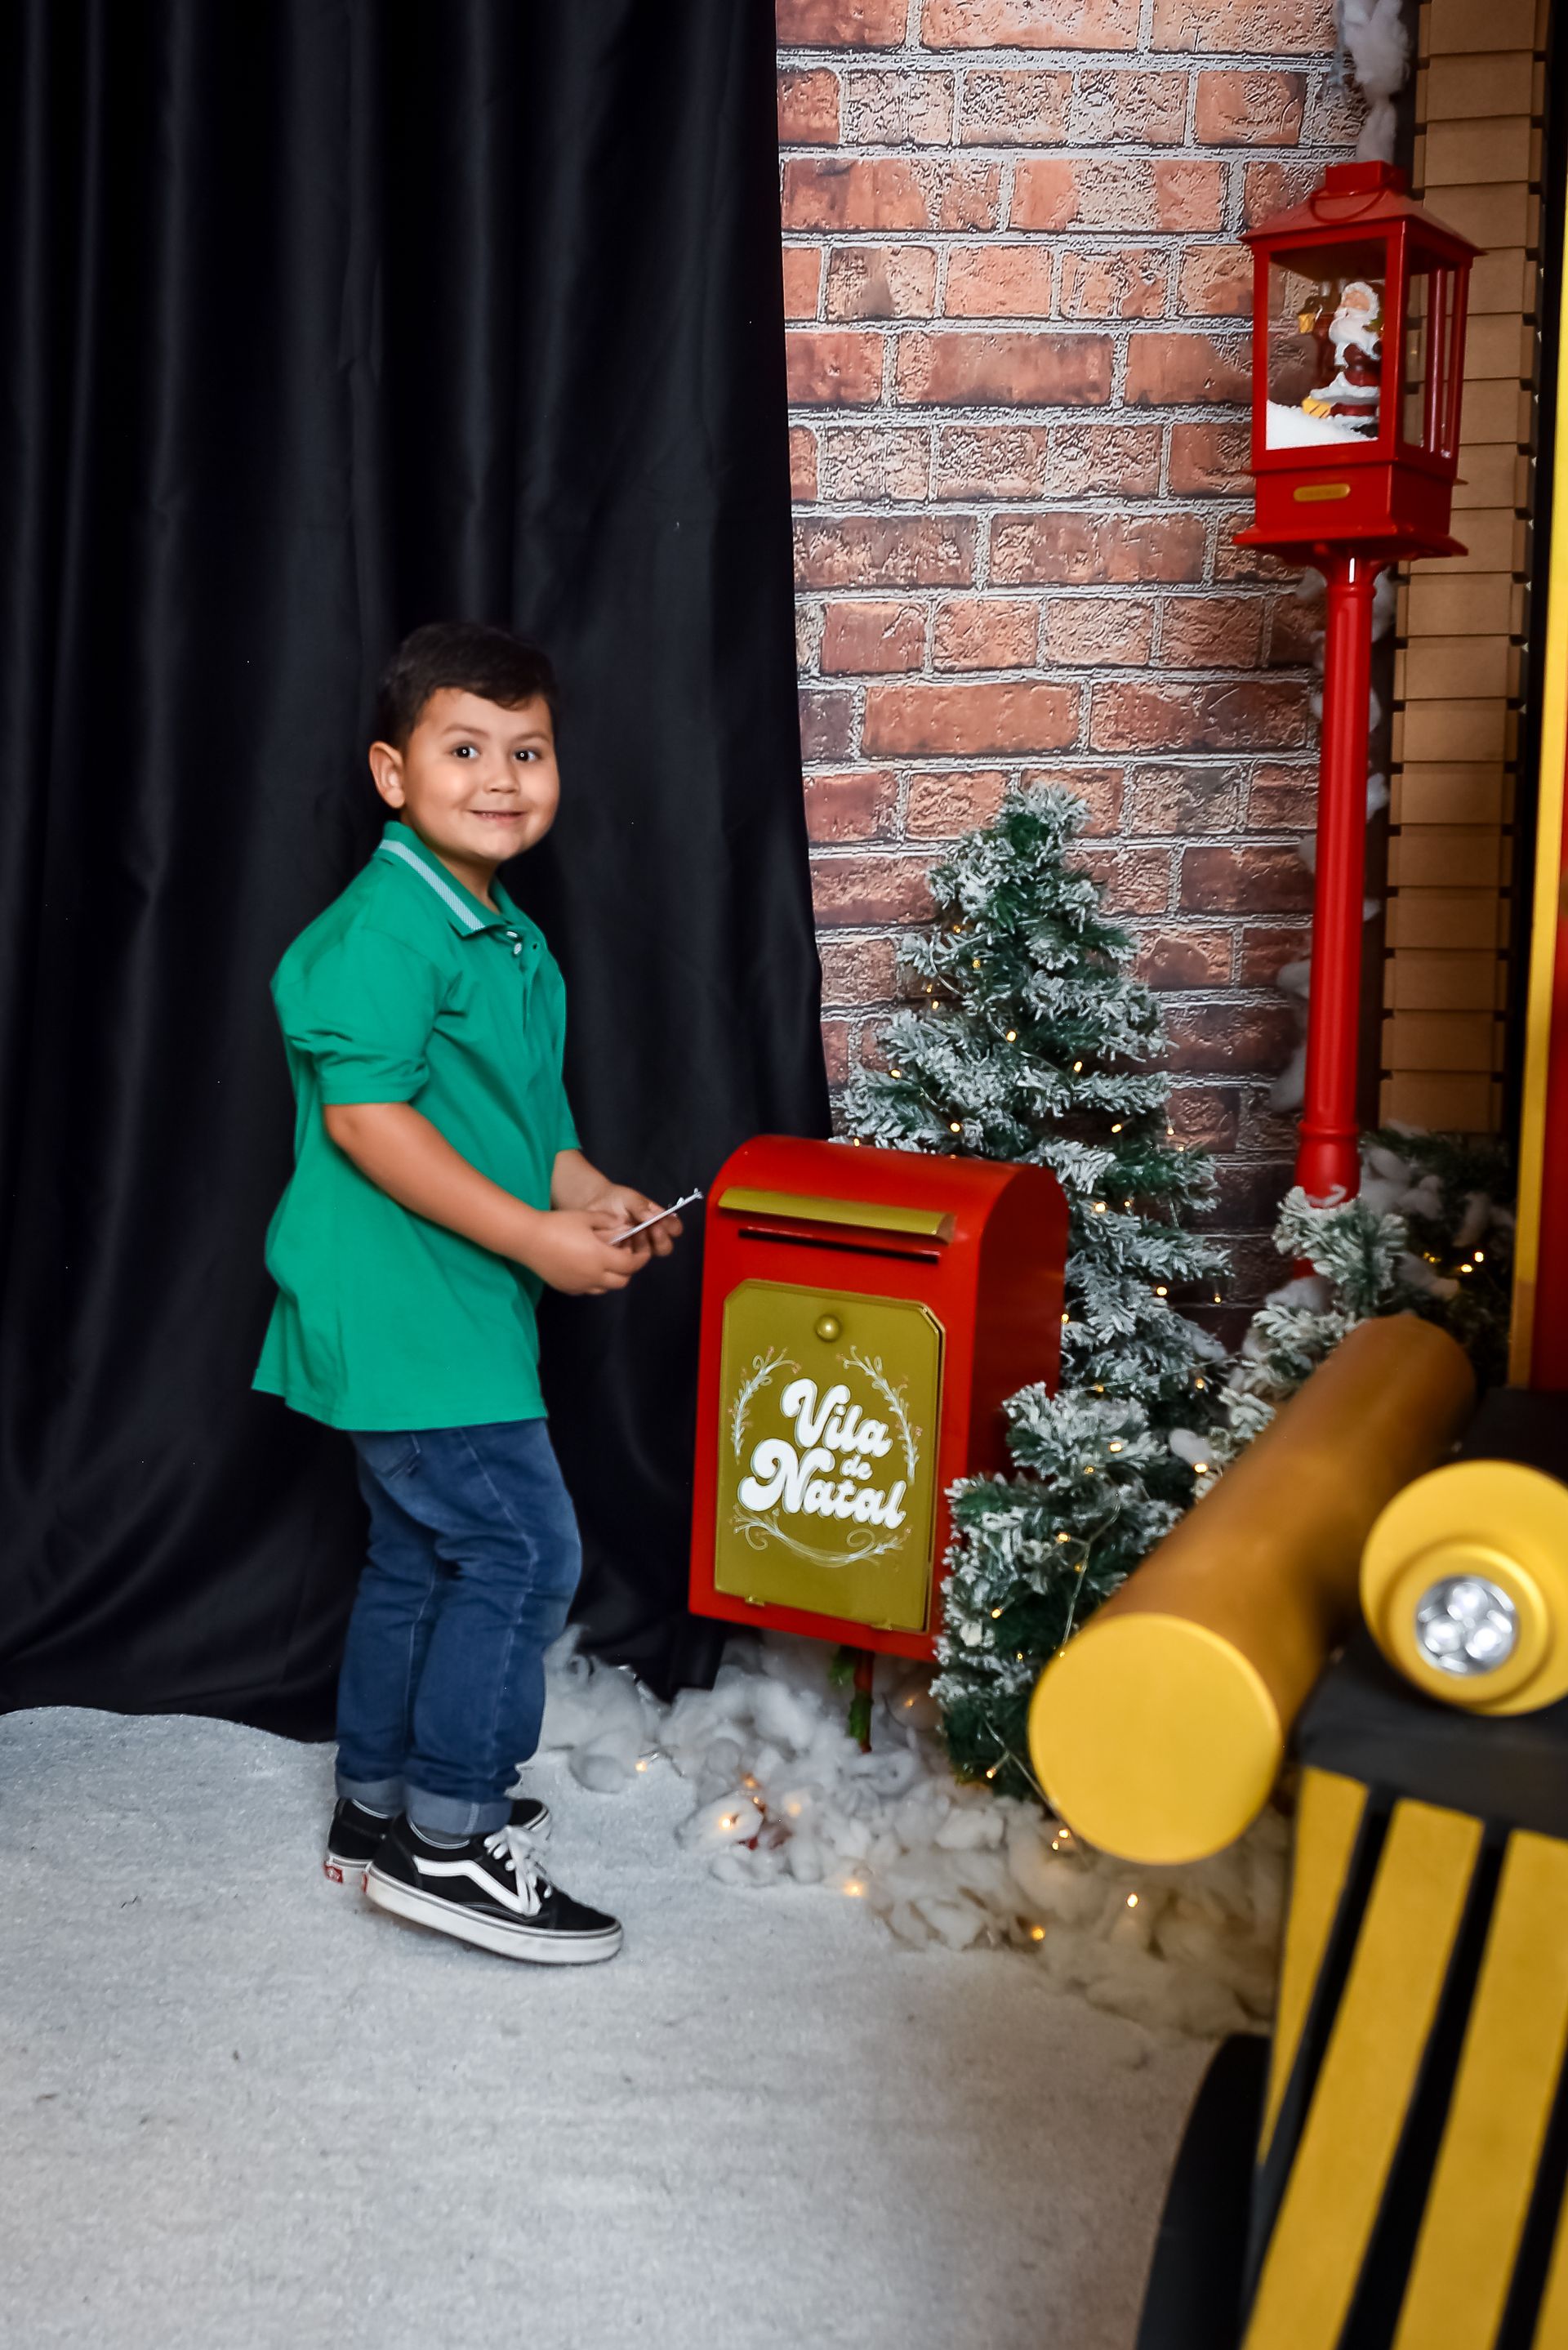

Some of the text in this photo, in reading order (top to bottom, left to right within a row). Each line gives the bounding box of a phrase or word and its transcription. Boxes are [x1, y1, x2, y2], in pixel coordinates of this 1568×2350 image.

[782, 1378, 893, 1457] Vila
[738, 1438, 906, 1529] Natal
[840, 1456, 872, 1480] de
